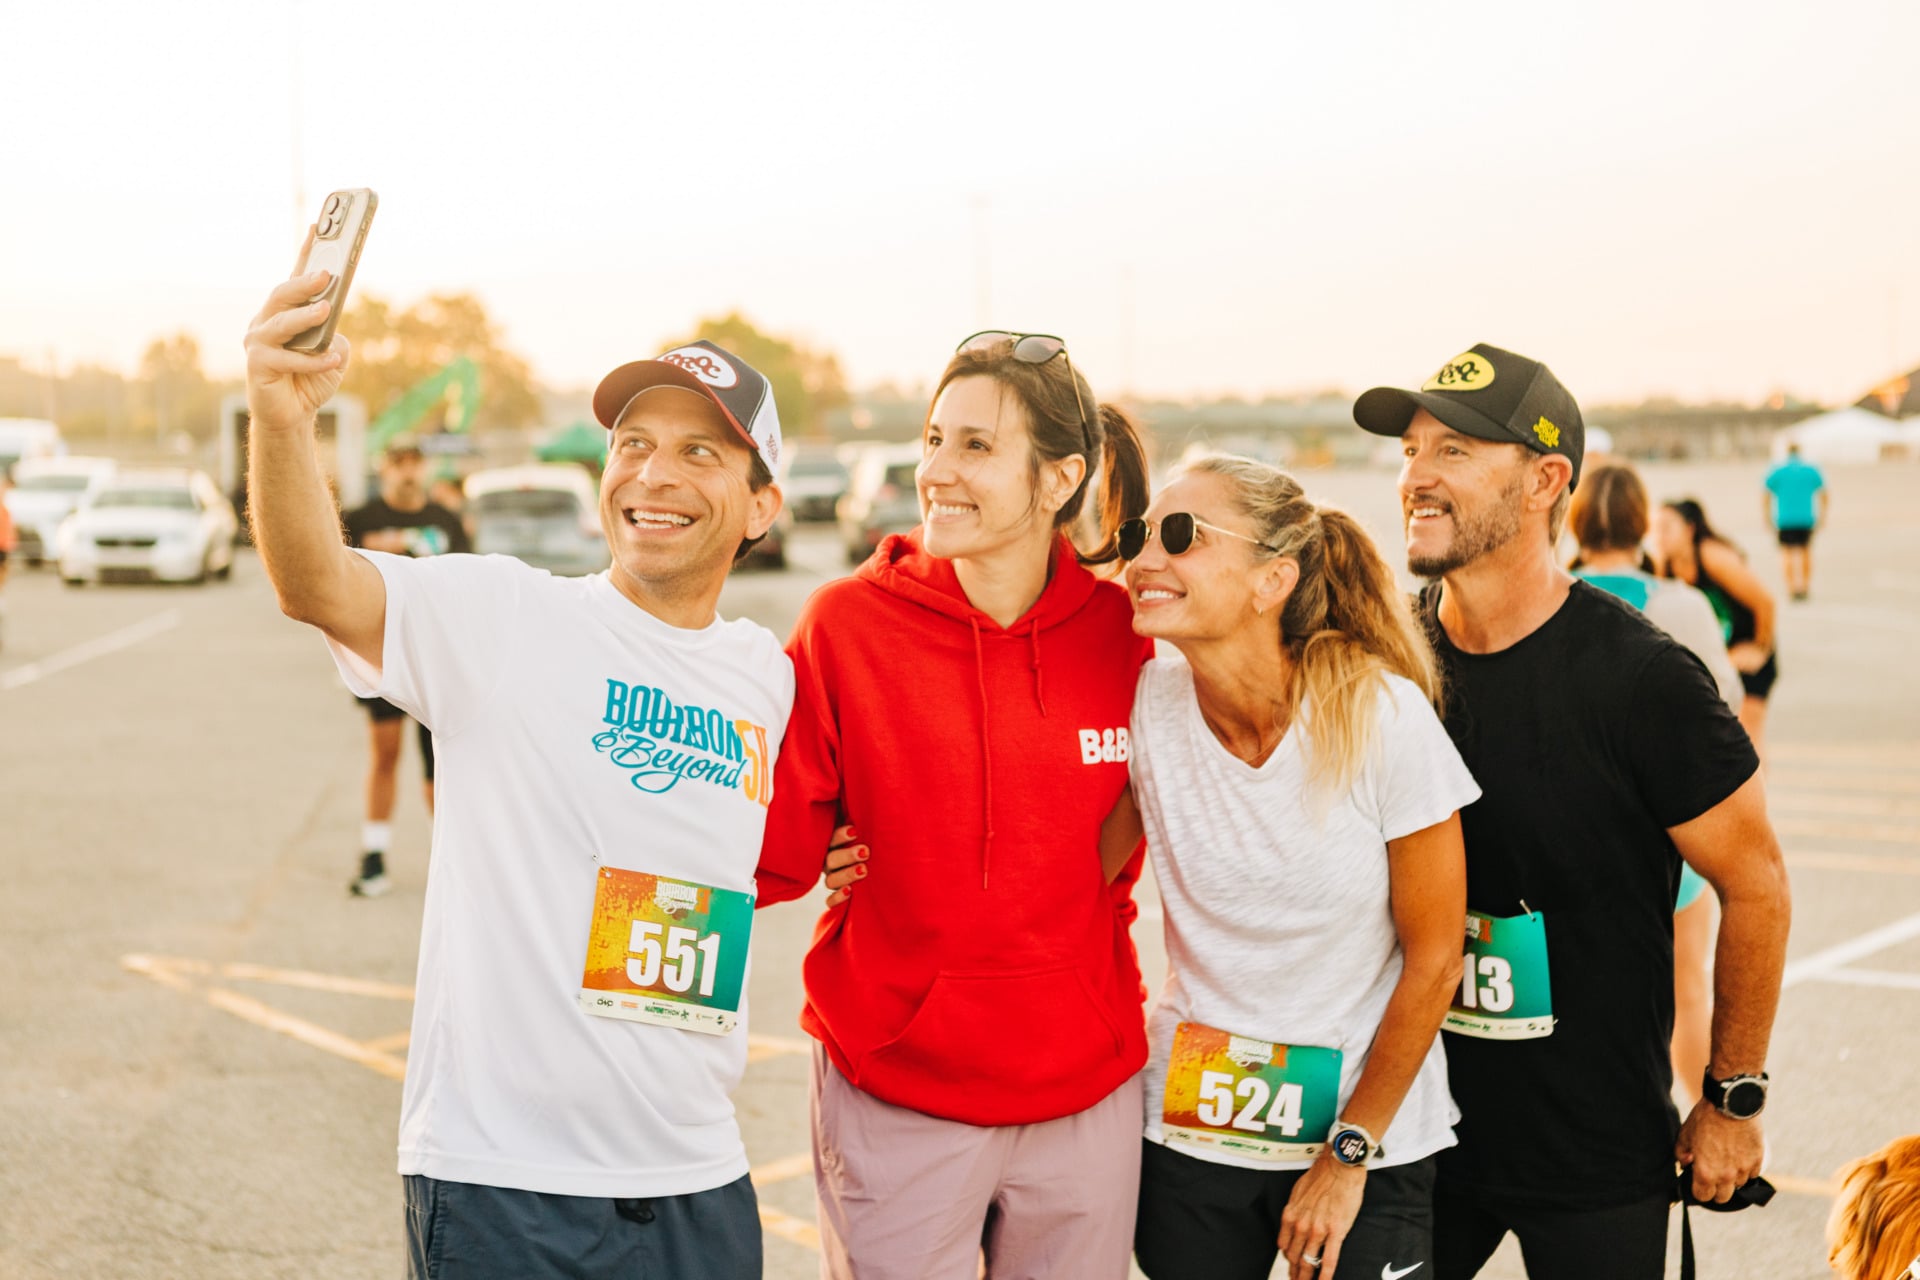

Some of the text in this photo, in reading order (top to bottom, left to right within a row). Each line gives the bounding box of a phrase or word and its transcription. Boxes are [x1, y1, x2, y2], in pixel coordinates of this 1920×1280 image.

[602, 678, 743, 763] BOURBON
[1078, 727, 1129, 765] B&B
[610, 733, 748, 794] Beyond
[626, 919, 721, 997] 551
[1197, 1070, 1304, 1137] 524
